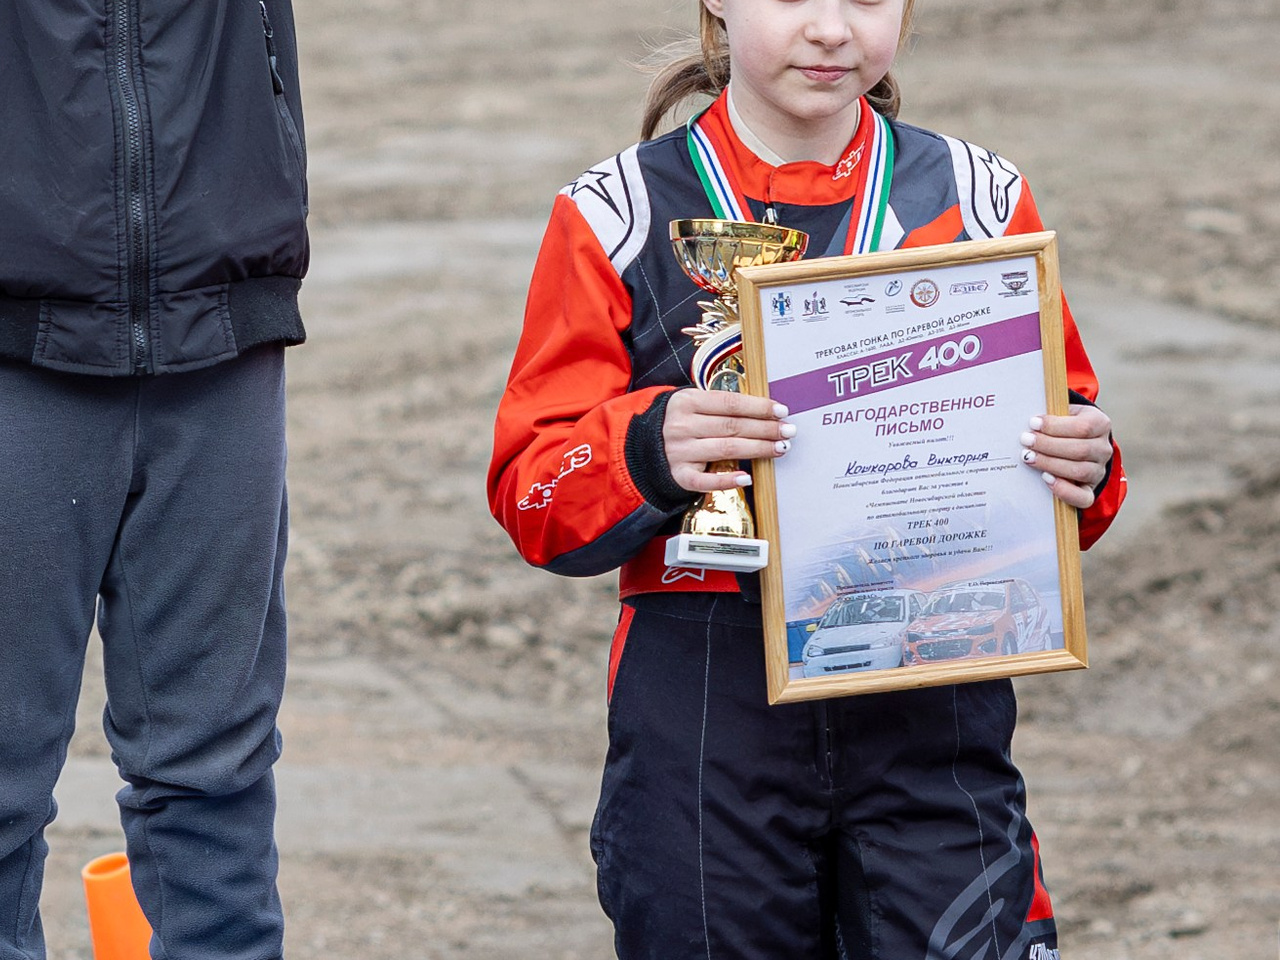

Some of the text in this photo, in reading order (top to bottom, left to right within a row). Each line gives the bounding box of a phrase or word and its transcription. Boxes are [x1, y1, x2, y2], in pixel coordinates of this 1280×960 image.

[814, 306, 990, 358] ТРЕКОВАЯ ГОНКА ПО ГАРЕВОЙ ДОРОЖКЕ
[827, 335, 980, 396] ТРЕК 400
[822, 394, 994, 425] БЛАГОДАРСТВЕННОЕ
[875, 417, 943, 436] ПИСЬМО
[907, 517, 949, 529] ТРЕК 400
[873, 529, 987, 550] ПО ГАРЕВОЙ ДОРОЖКЕ
